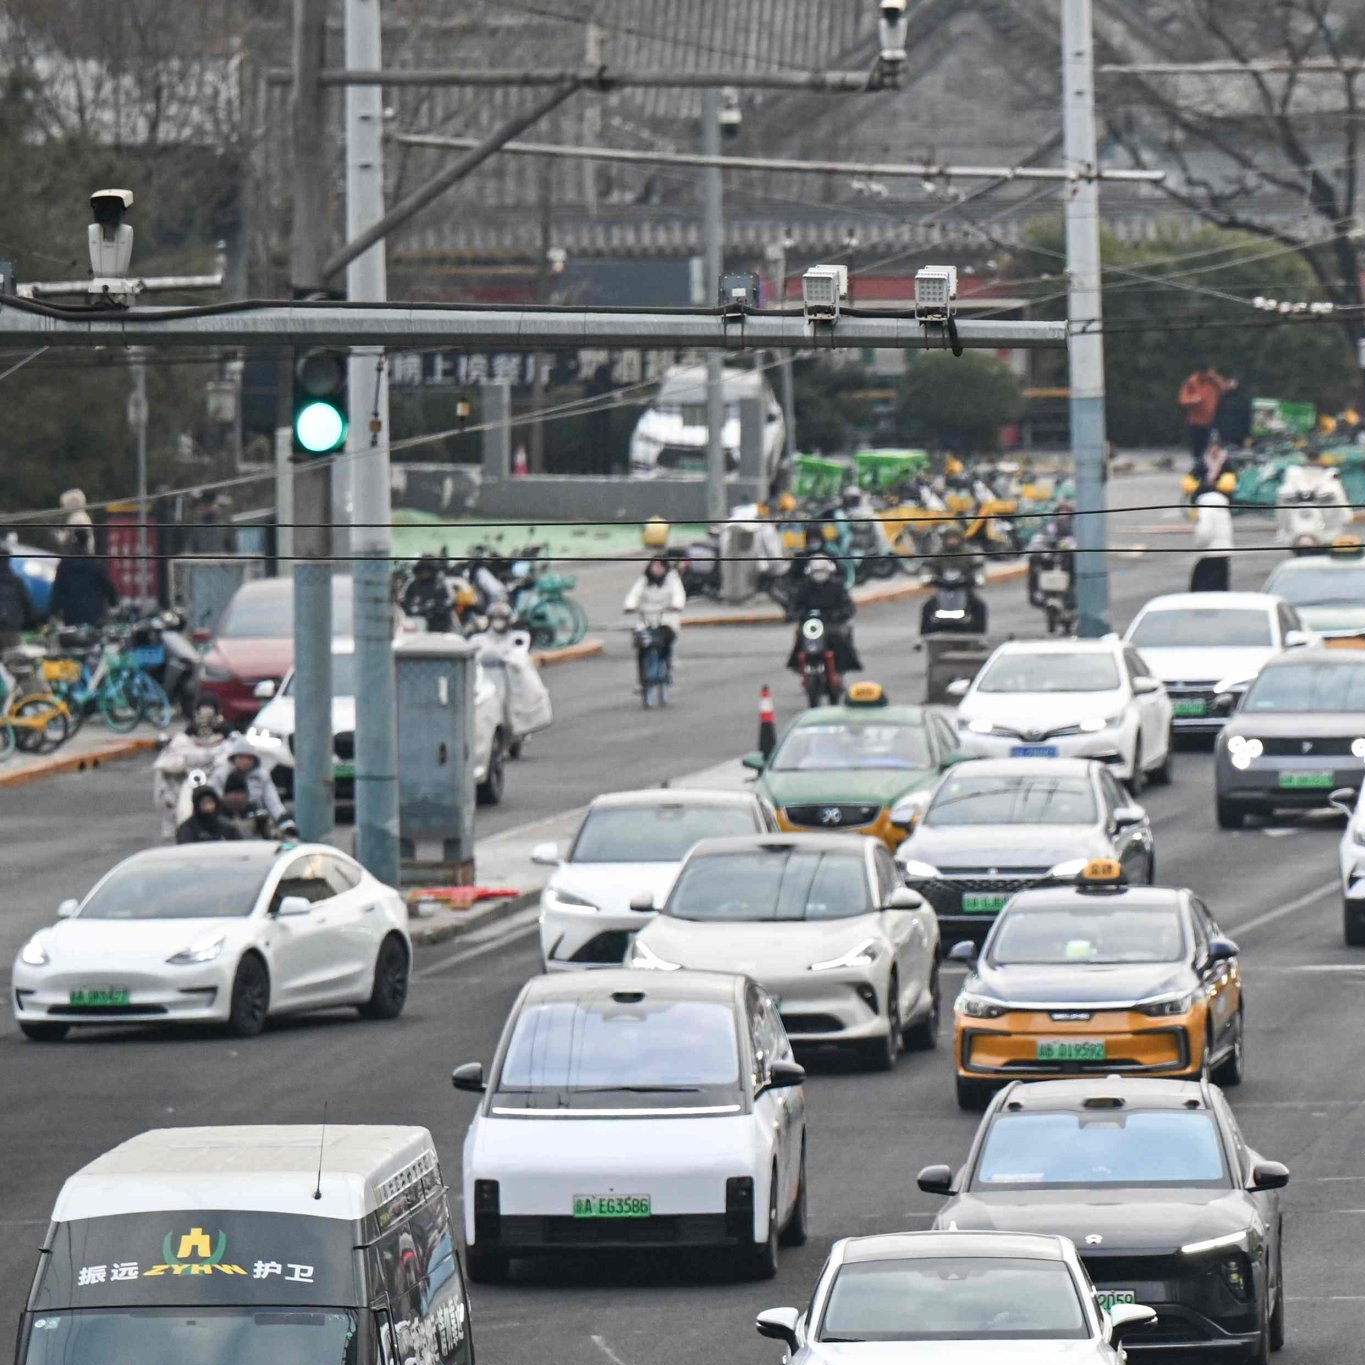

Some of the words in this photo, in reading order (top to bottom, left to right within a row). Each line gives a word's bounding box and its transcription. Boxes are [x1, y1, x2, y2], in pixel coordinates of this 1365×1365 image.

[78, 1262, 139, 1285] 振远
[143, 1264, 248, 1276] ZYHW
[254, 1261, 314, 1282] 护卫
